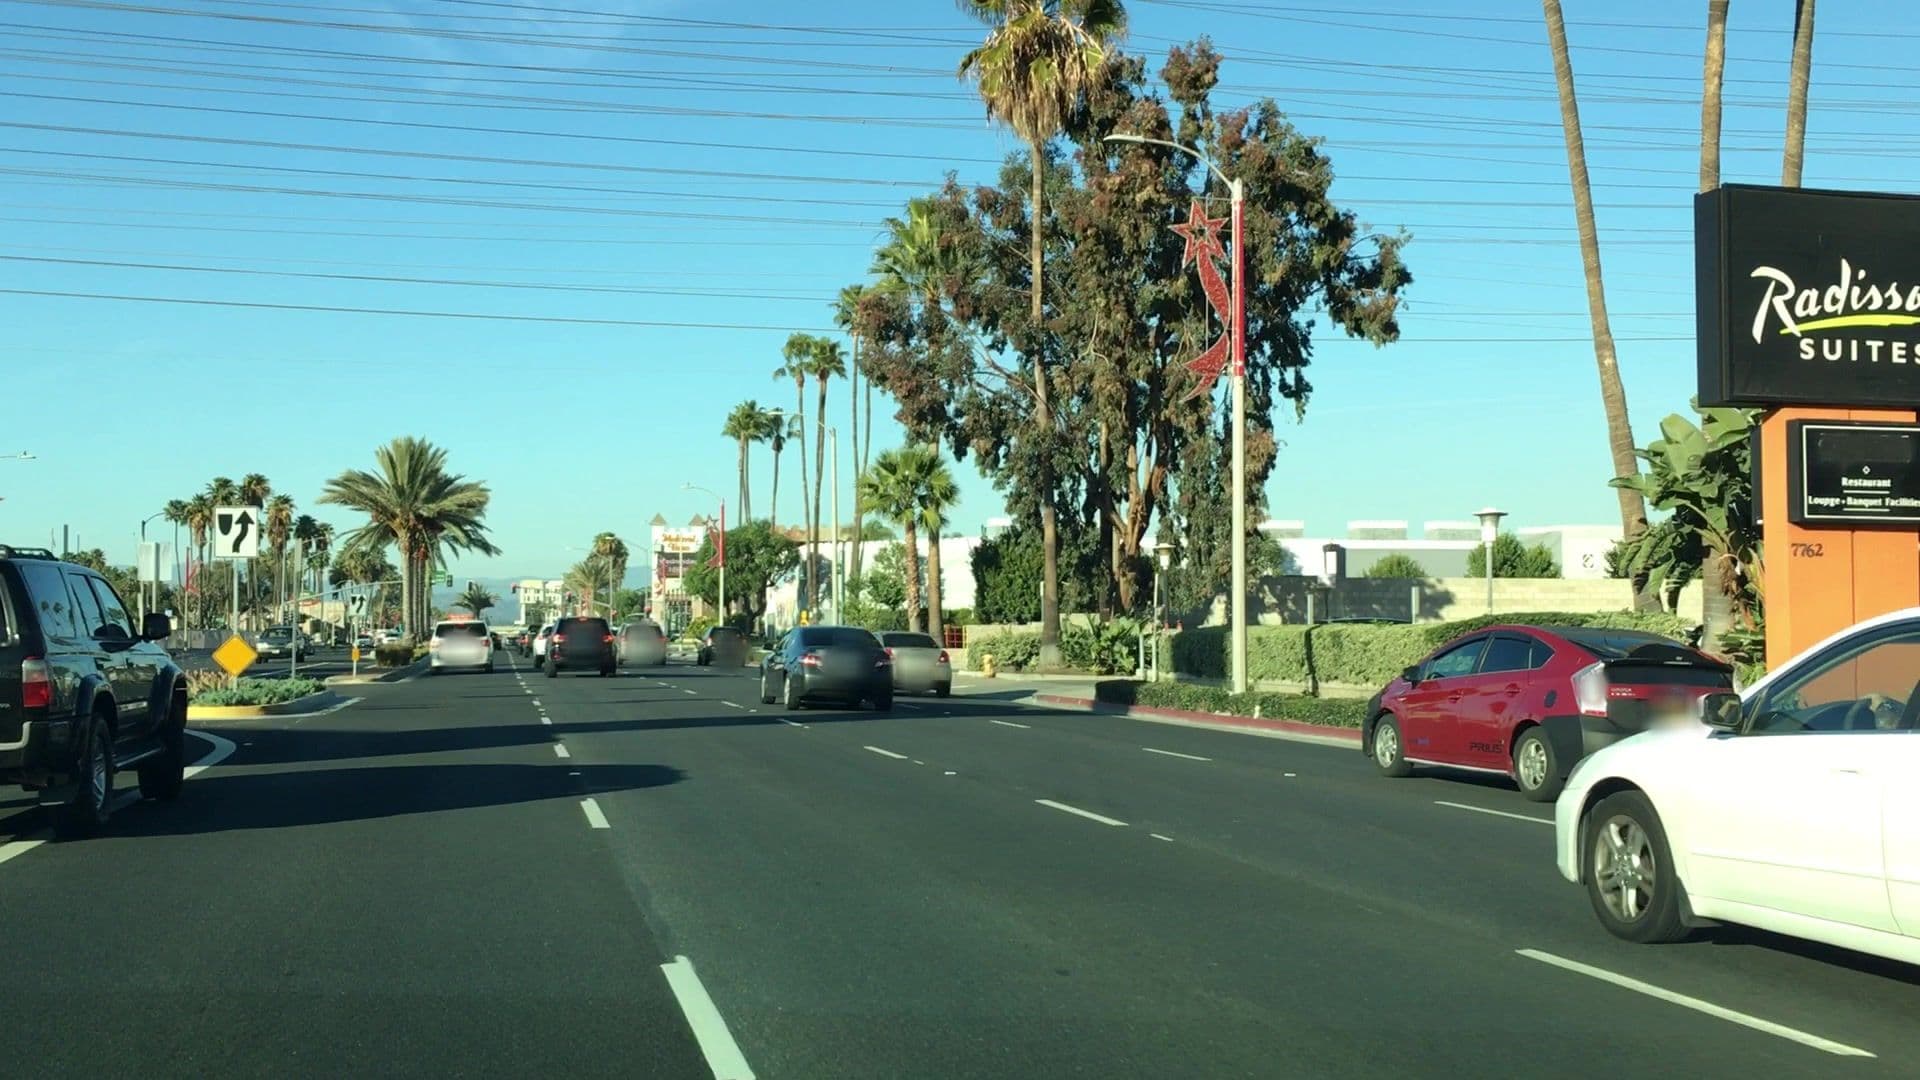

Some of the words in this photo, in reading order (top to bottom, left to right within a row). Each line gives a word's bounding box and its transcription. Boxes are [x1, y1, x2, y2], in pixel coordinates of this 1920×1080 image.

[1841, 477, 1891, 487] Restaurant
[1847, 496, 1882, 508] Banquet
[1791, 543, 1824, 558] 7762
[1470, 742, 1503, 753] PRIUS
